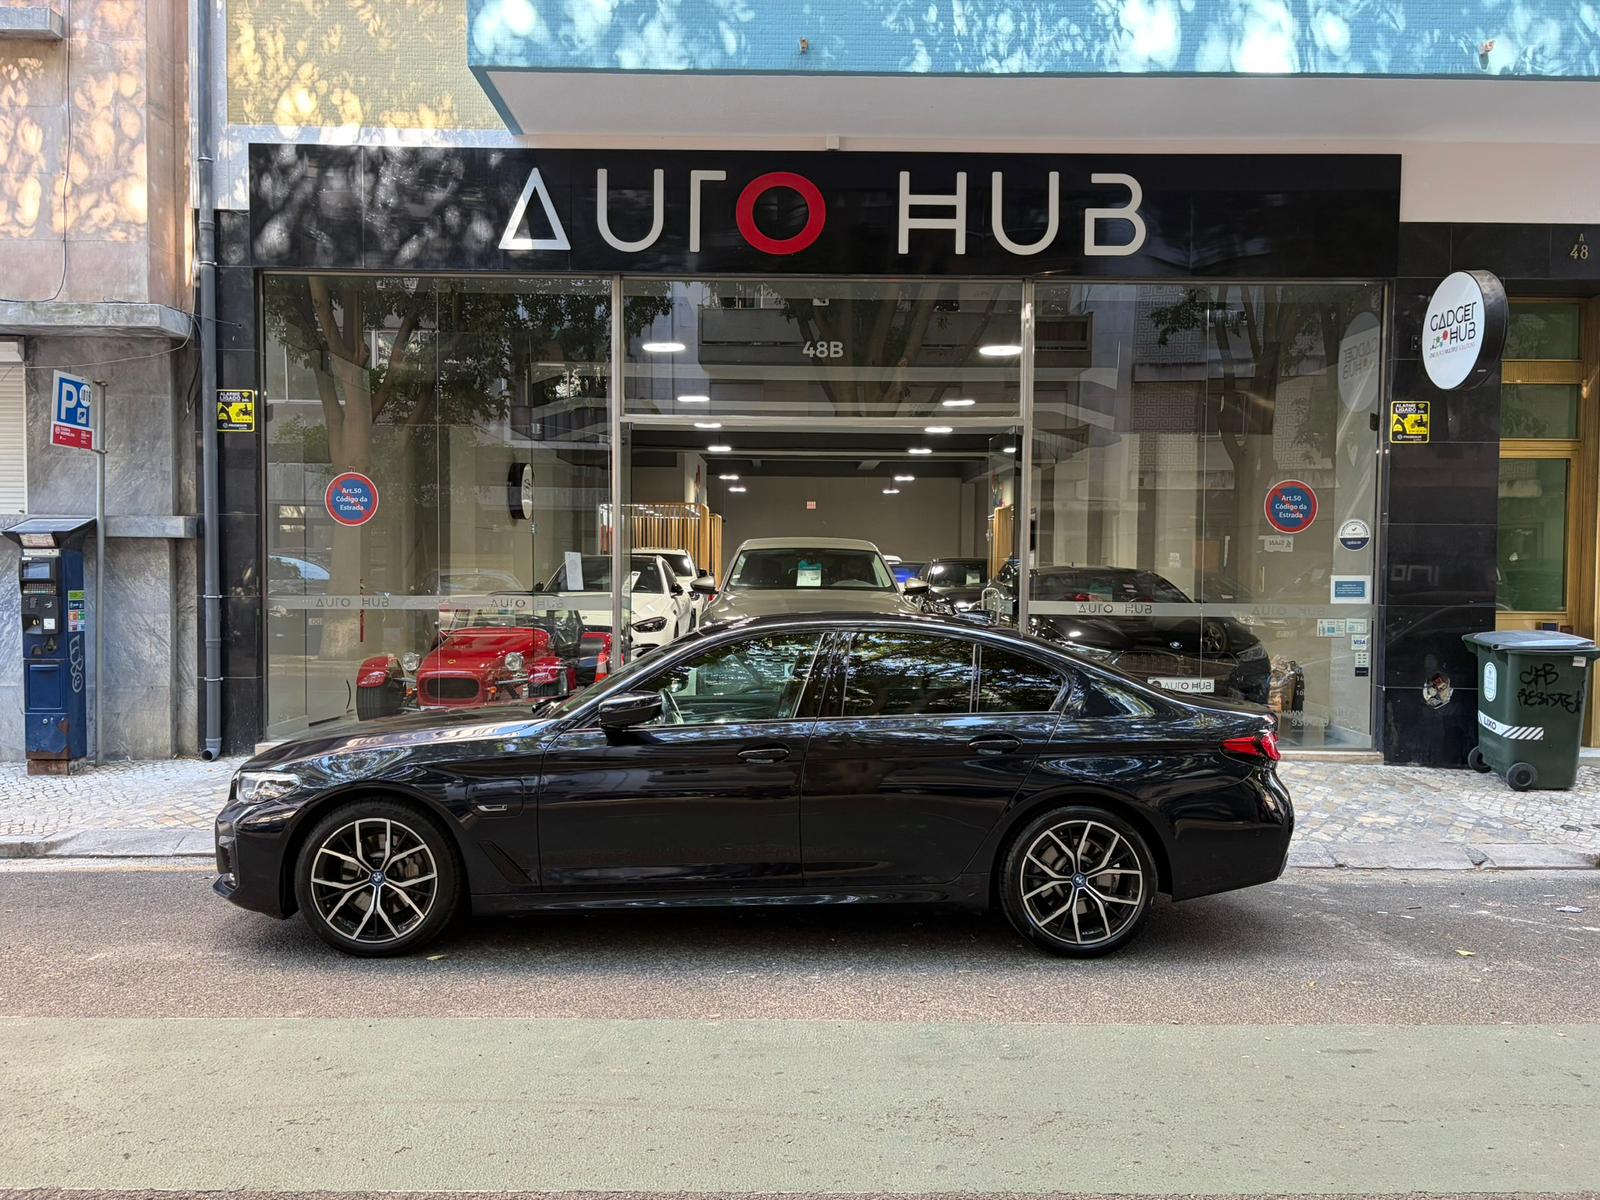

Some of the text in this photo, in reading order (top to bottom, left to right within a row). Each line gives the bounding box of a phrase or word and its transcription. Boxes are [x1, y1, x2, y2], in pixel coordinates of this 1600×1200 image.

[498, 167, 1146, 256] AUTO HUB
[1579, 233, 1585, 242] A
[1570, 244, 1589, 260] 48
[1430, 302, 1477, 332] GADGET
[1449, 321, 1477, 345] HUB
[802, 341, 844, 358] 48B
[61, 382, 77, 420] P
[335, 495, 359, 504] Código
[1275, 501, 1298, 511] Código
[1279, 511, 1303, 519] Estrada
[315, 598, 388, 607] AUTO HUB
[490, 599, 526, 608] AUTO
[1078, 604, 1153, 614] AUTO HUB
[1164, 682, 1212, 691] AUTO HUB
[1483, 716, 1497, 731] LIXO
